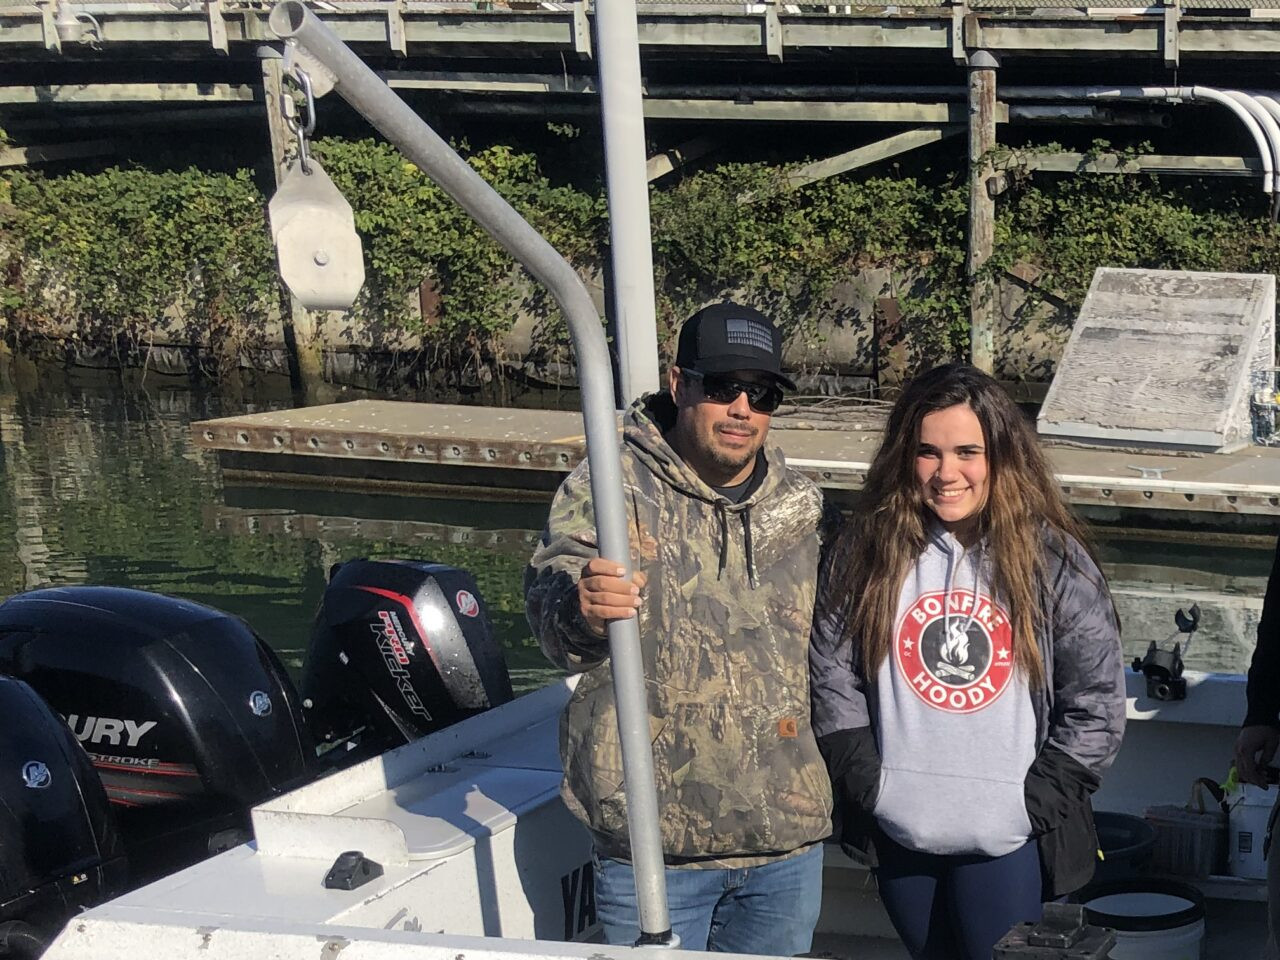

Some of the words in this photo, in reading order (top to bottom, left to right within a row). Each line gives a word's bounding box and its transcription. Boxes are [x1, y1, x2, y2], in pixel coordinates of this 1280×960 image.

[378, 610, 411, 664] PRO
[912, 671, 997, 708] HOODY
[60, 712, 158, 747] URY
